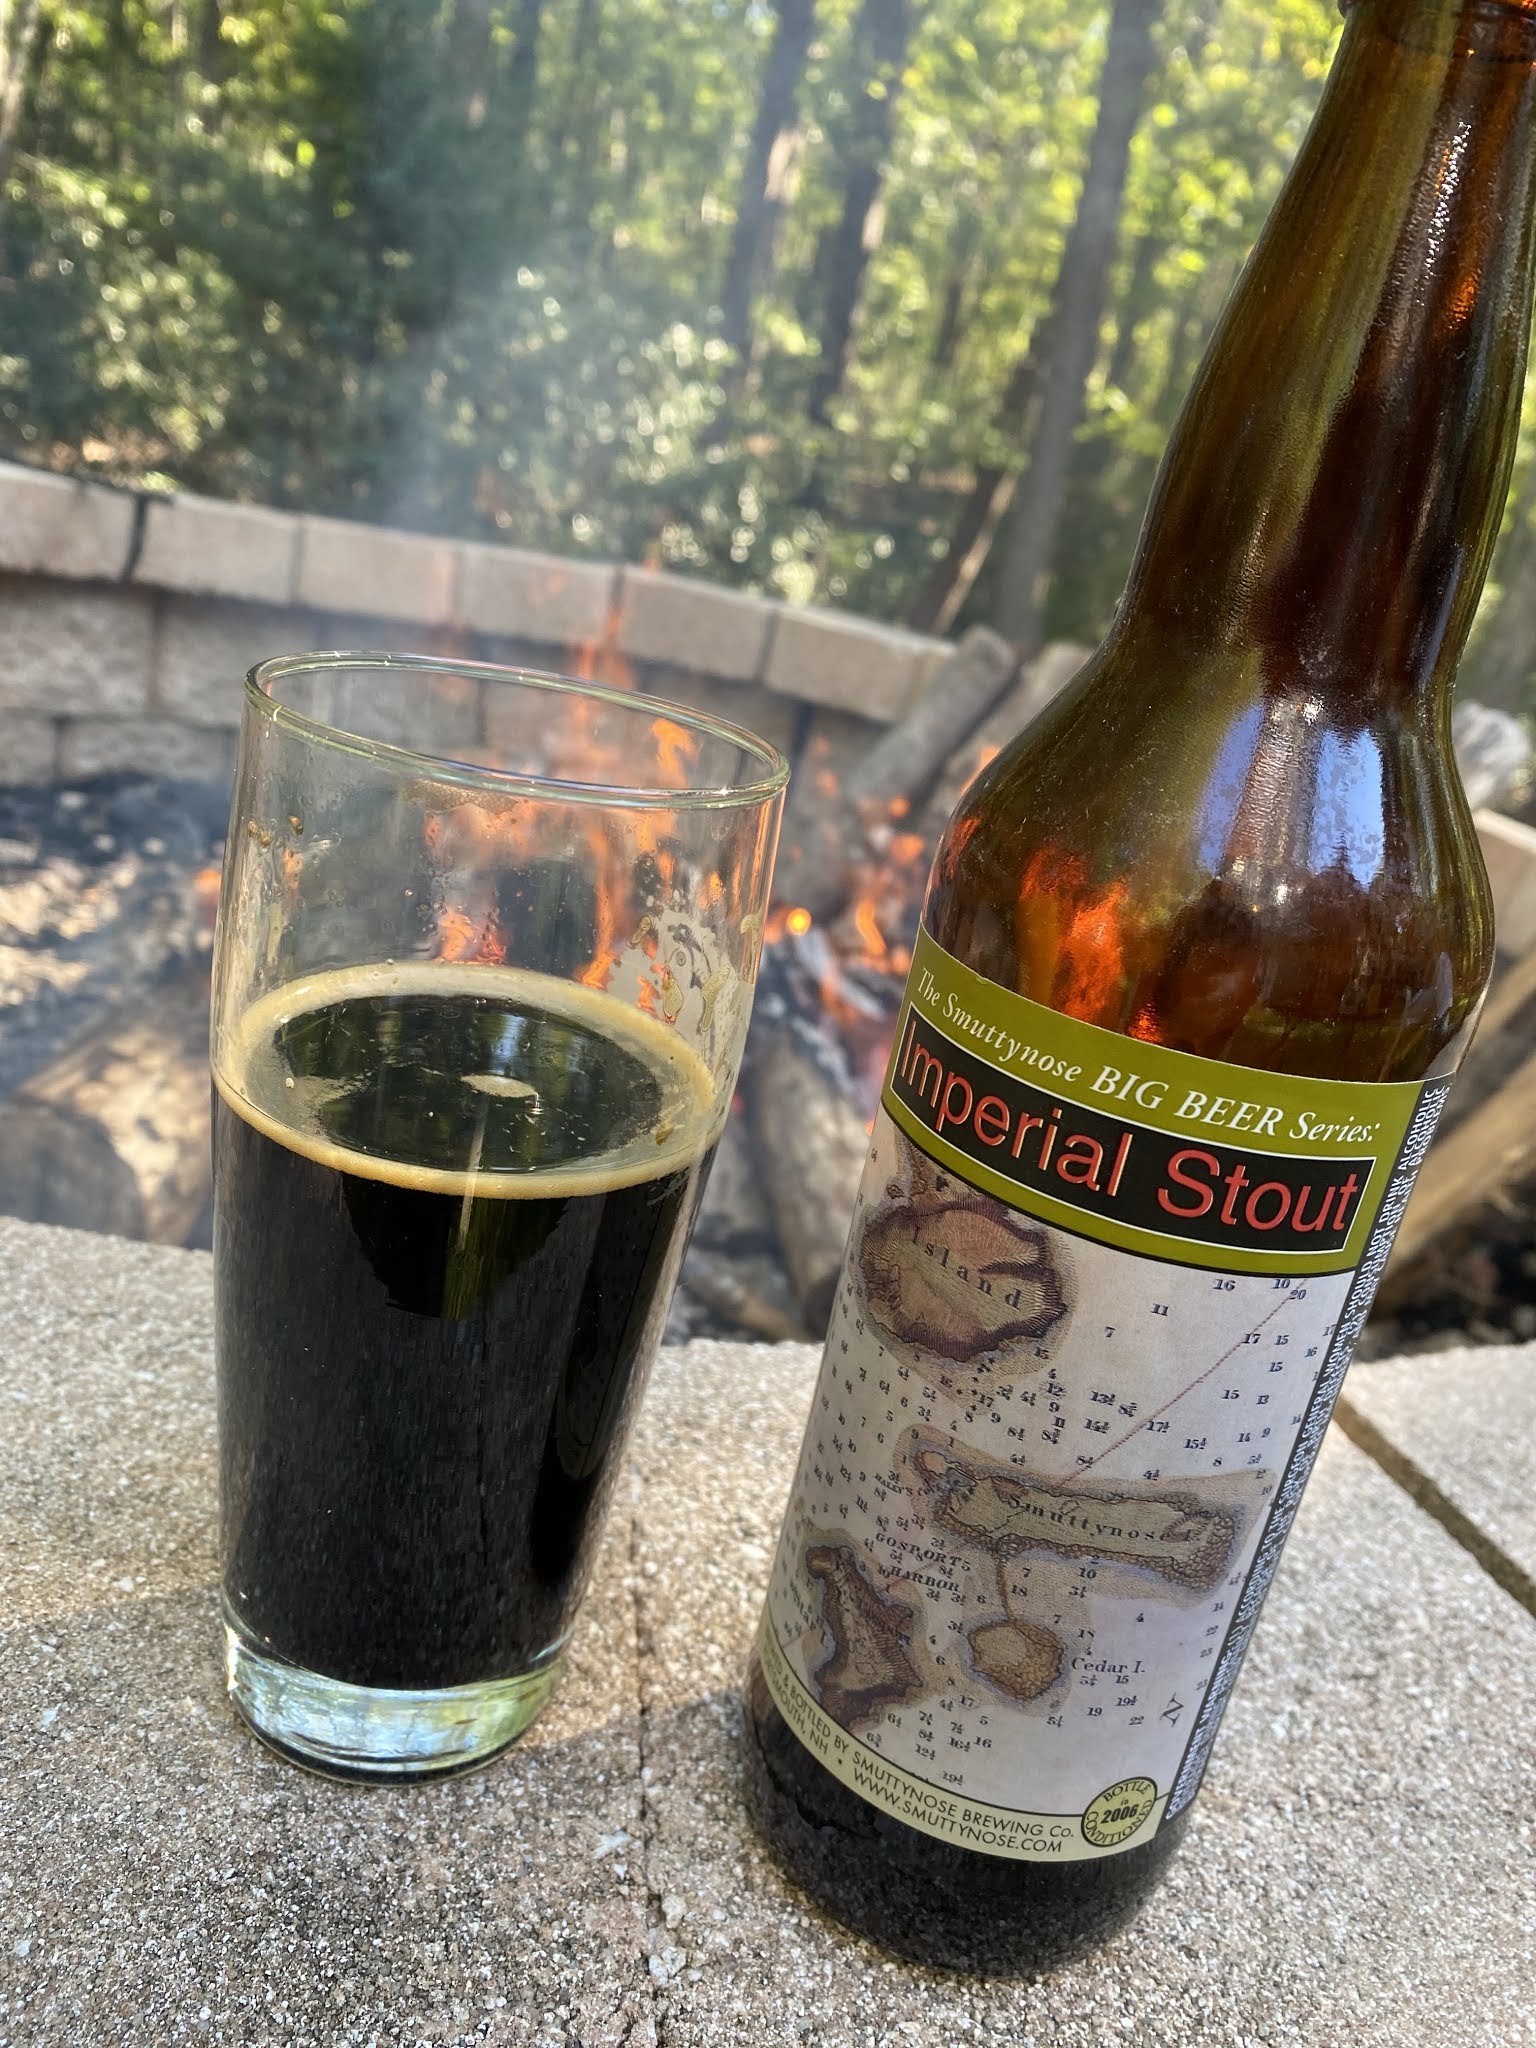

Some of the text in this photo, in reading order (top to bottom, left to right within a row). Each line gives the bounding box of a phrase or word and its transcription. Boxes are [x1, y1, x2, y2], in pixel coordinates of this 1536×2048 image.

[917, 967, 1381, 1143] The Smuttynose BIG BEER Series:
[901, 1019, 1358, 1232] Imperial Stout
[1409, 1085, 1446, 1166] ALCOHOLIC
[1324, 1324, 1346, 1377] WOMEN
[1345, 1260, 1373, 1319] SHOULD
[1367, 1228, 1385, 1257] NOT
[1379, 1176, 1404, 1223] DRINK
[1398, 1090, 1438, 1170] ALCOHOLIC
[1212, 1279, 1236, 1292] 16
[1272, 1278, 1291, 1289] 10
[1289, 1290, 1307, 1300] 20
[1150, 1303, 1169, 1316] 11
[1104, 1326, 1116, 1338] 7
[1242, 1333, 1261, 1344] 17
[1274, 1335, 1290, 1345] 15
[1269, 1361, 1283, 1373] 15
[1221, 1389, 1240, 1400] 15
[875, 1532, 962, 1567] GOSPORT
[889, 1565, 960, 1592] HARBOR
[1071, 1657, 1128, 1674] Cedar
[1115, 1675, 1130, 1685] 15
[1086, 1707, 1103, 1716] 19
[973, 1736, 993, 1749] 16
[790, 1685, 831, 1738] BOTTLED
[834, 1735, 849, 1753] BY
[852, 1752, 957, 1817] SMUTTYNOSE
[962, 1809, 1044, 1837] BREWING
[1049, 1825, 1075, 1838] Co.
[810, 1731, 829, 1755] NH
[853, 1767, 1062, 1852] WWW.SMUTTYNOSE.COM
[1102, 1780, 1152, 1802] BOTTLE
[1085, 1799, 1152, 1843] CONDITIONED
[1100, 1803, 1140, 1824] 2006
